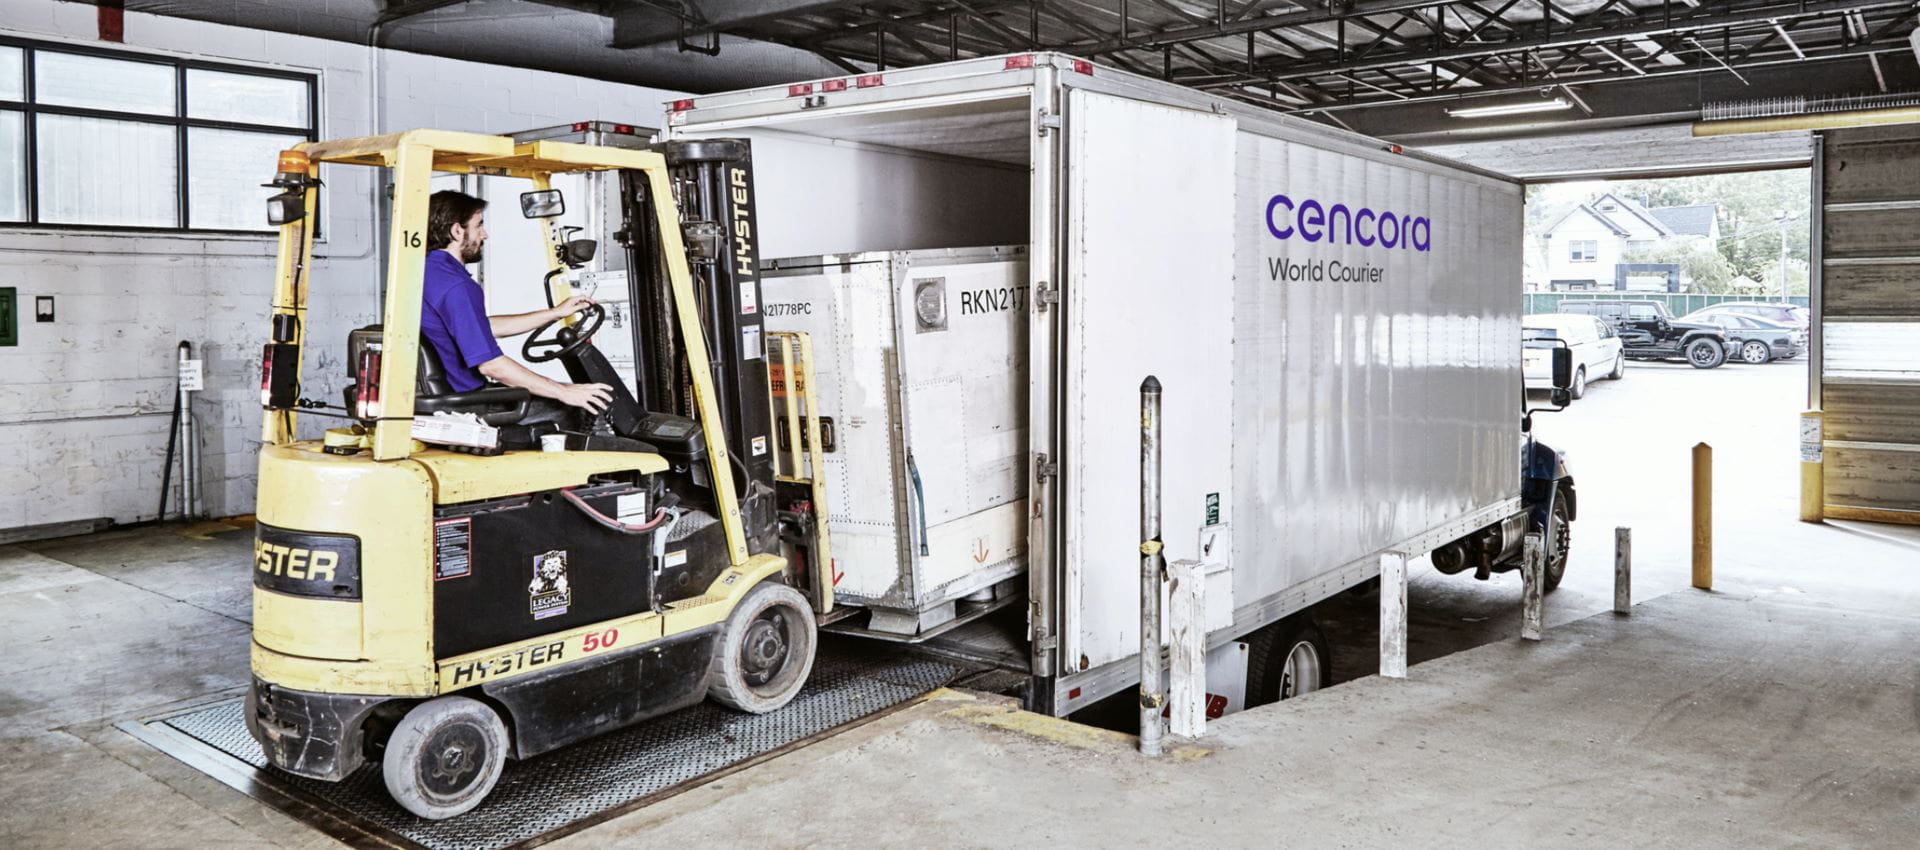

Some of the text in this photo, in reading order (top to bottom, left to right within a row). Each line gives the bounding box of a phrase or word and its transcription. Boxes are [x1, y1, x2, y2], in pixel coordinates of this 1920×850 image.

[403, 230, 421, 248] 16
[731, 168, 753, 275] HYSTER
[1266, 194, 1431, 252] cencora
[1268, 257, 1384, 283] World Courier
[533, 593, 569, 607] LEGACY
[453, 629, 618, 685] HYSTER 50
